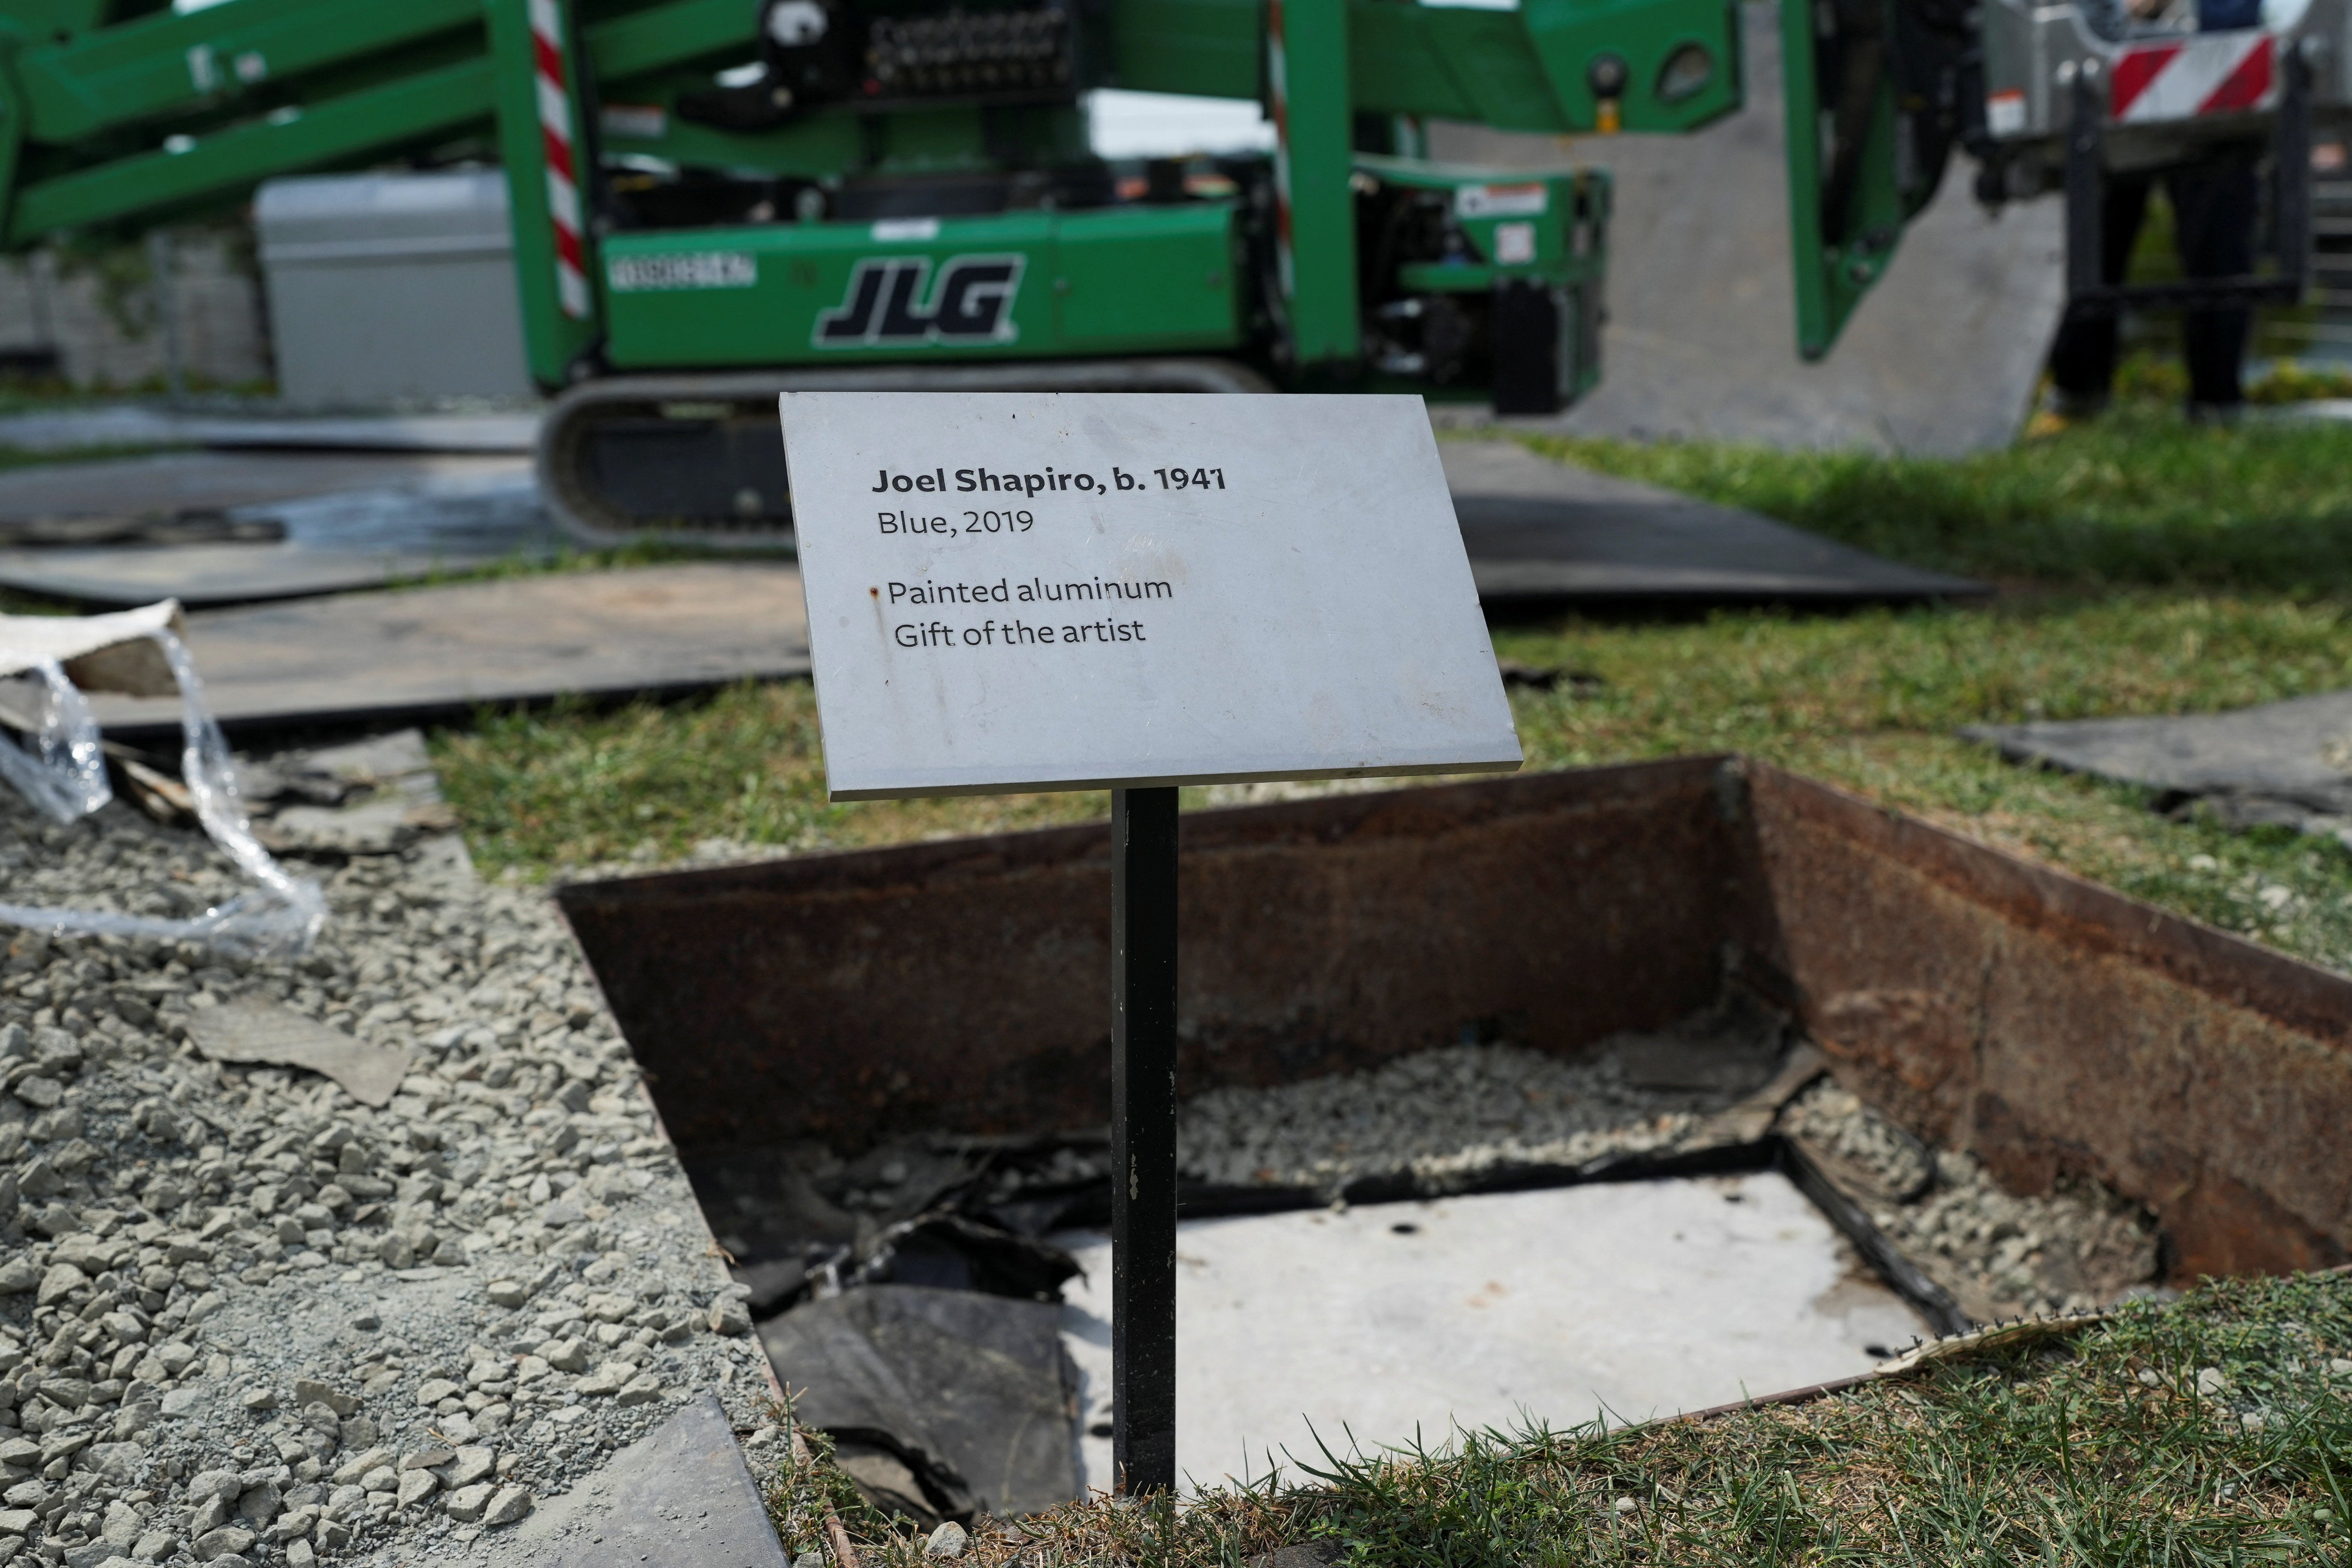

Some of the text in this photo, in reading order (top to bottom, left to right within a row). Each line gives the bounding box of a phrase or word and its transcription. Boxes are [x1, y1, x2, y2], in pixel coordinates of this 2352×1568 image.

[814, 255, 1023, 345] JLG
[872, 467, 1226, 498] Joel Shapiro, b. 1941
[878, 510, 1034, 538] Blue, 2019
[888, 576, 1173, 604] Painted aluminum
[895, 618, 1146, 647] Gift of the artist
